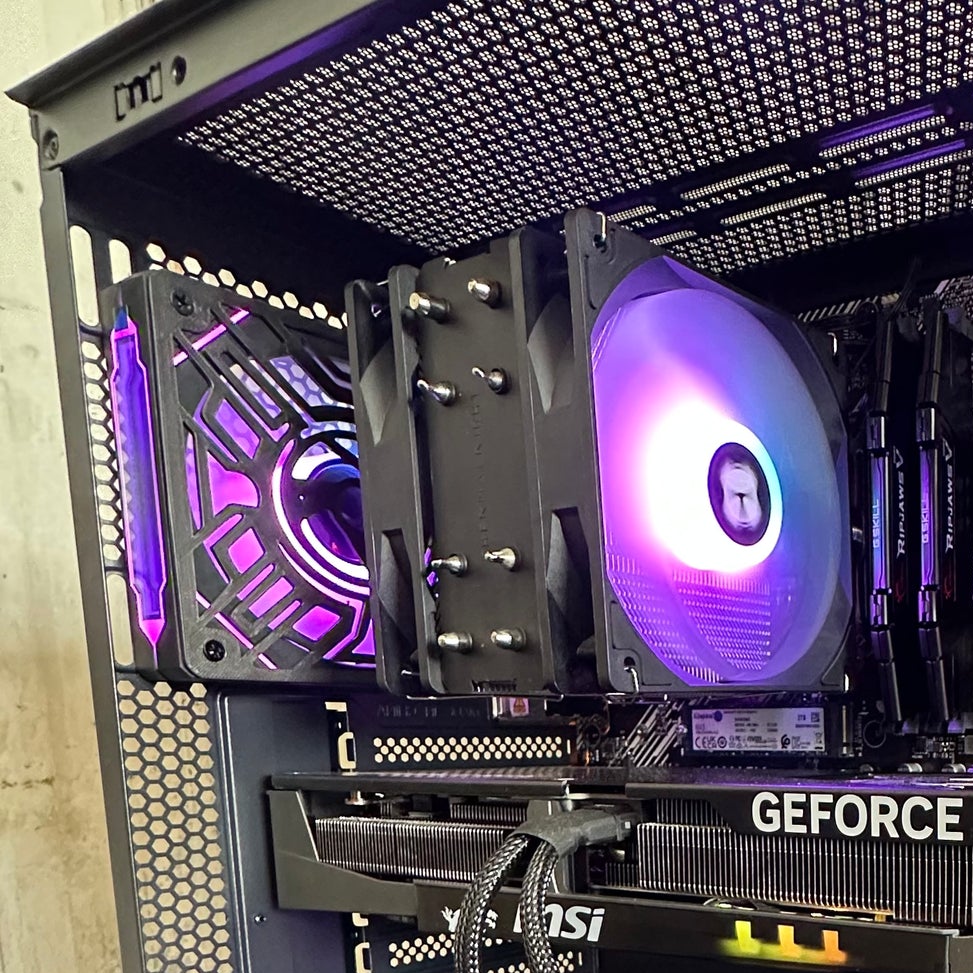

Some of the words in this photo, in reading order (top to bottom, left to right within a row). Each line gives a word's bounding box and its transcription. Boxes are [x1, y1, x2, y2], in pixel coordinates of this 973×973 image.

[895, 471, 906, 559] RIPJAWS
[944, 464, 955, 553] RIPJAWS
[752, 791, 964, 841] GEFORCE
